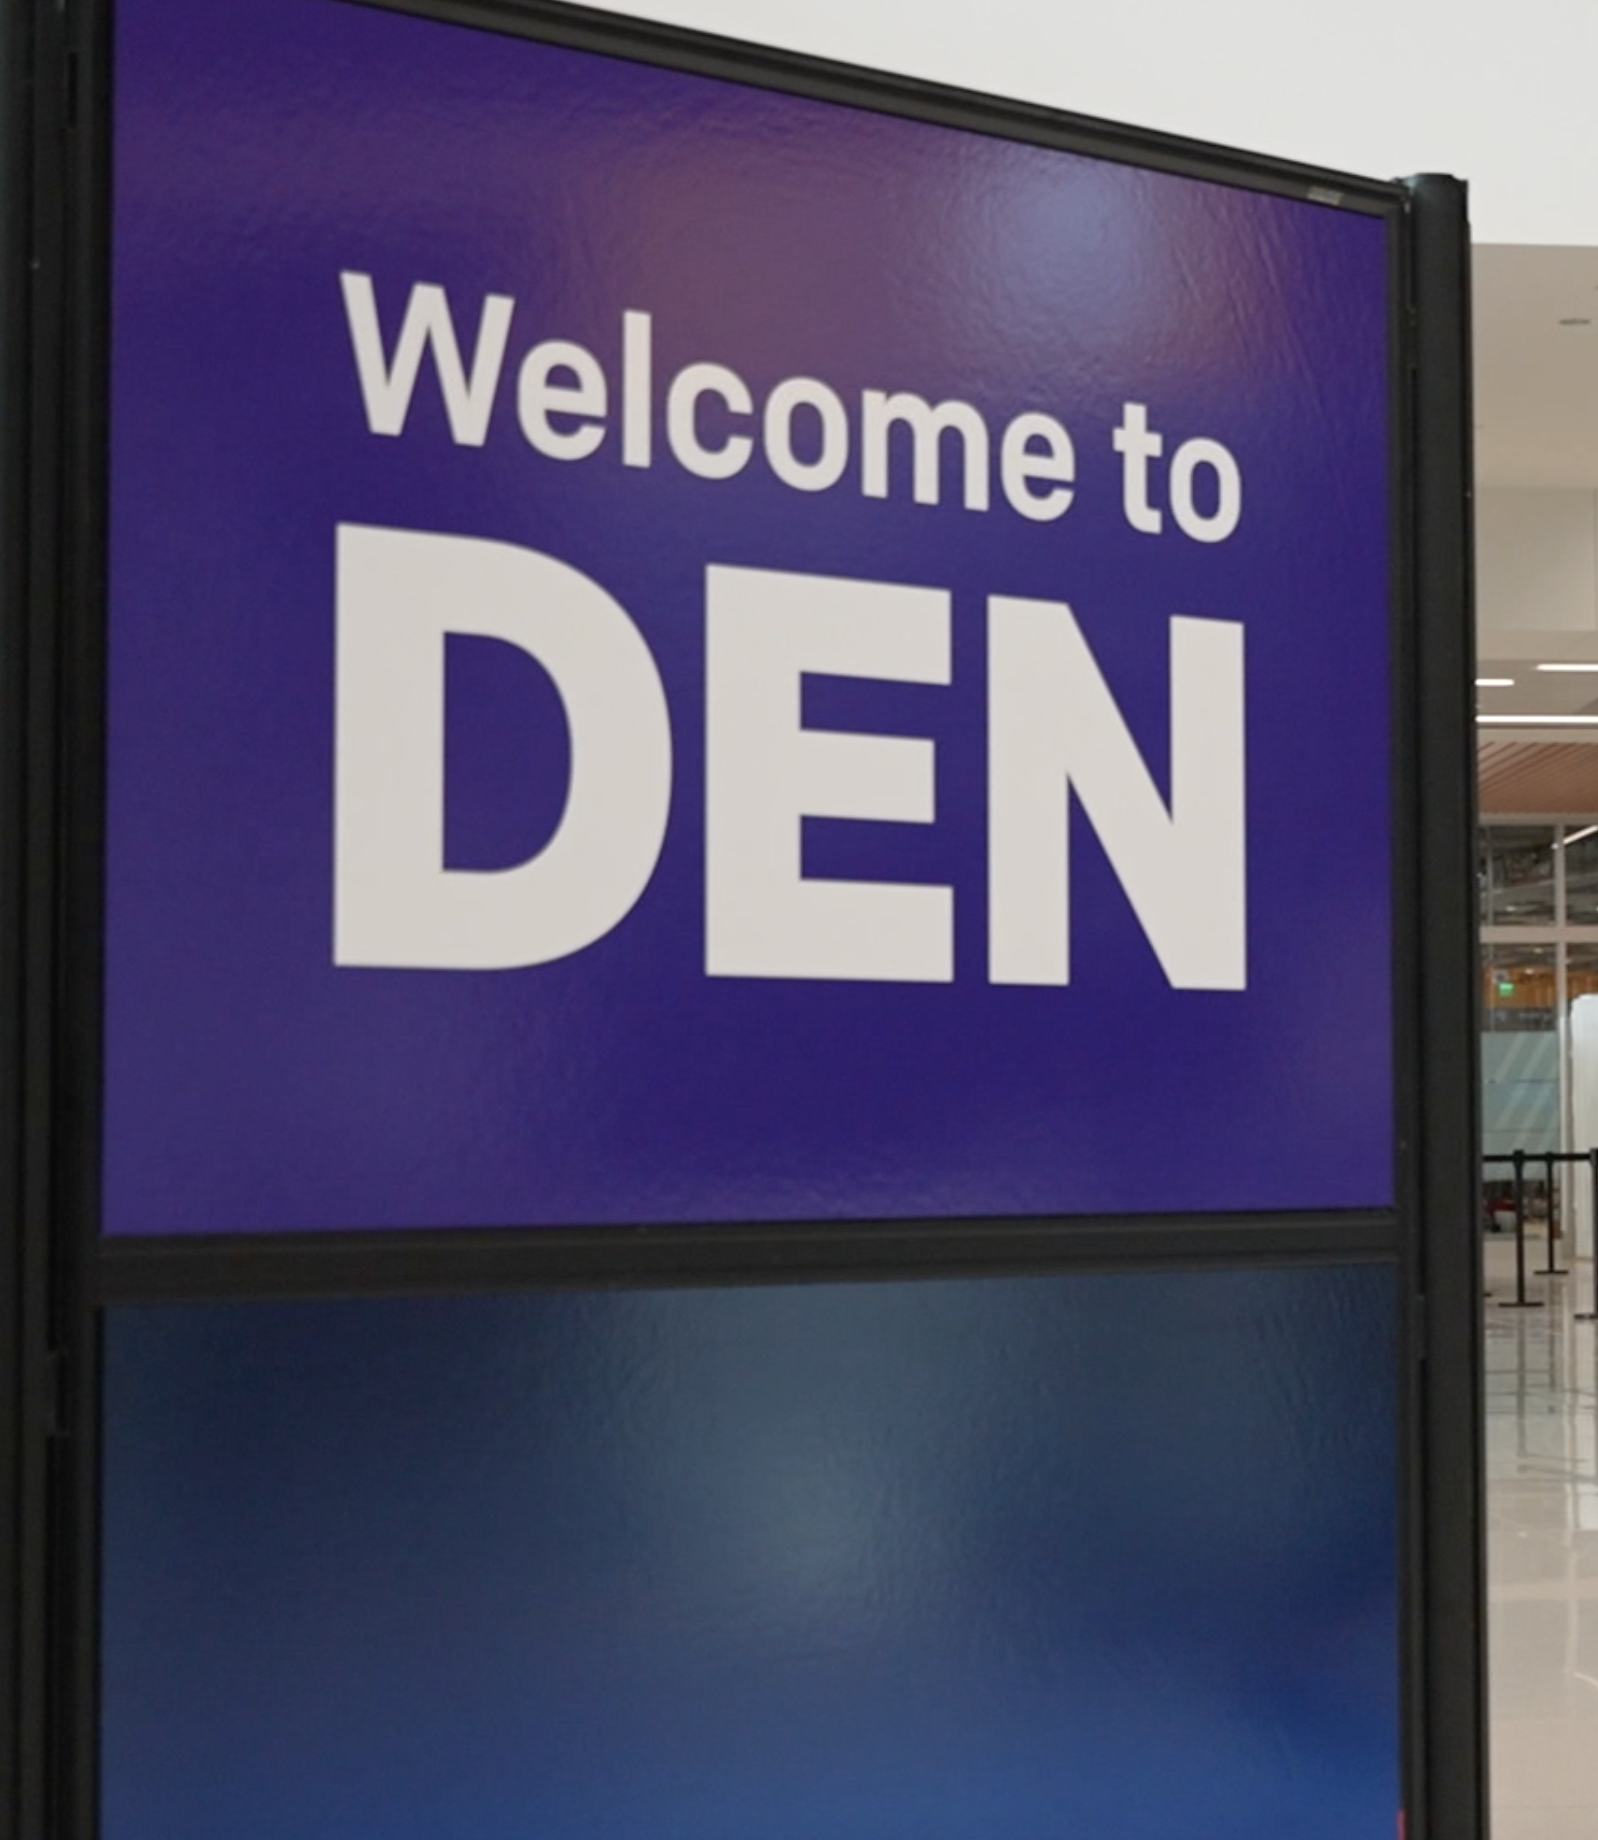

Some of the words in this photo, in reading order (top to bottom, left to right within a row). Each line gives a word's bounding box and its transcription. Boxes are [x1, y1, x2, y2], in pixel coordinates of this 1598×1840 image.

[340, 271, 1075, 521] Welcome
[1113, 402, 1241, 542] to
[334, 522, 1246, 990] DEN
